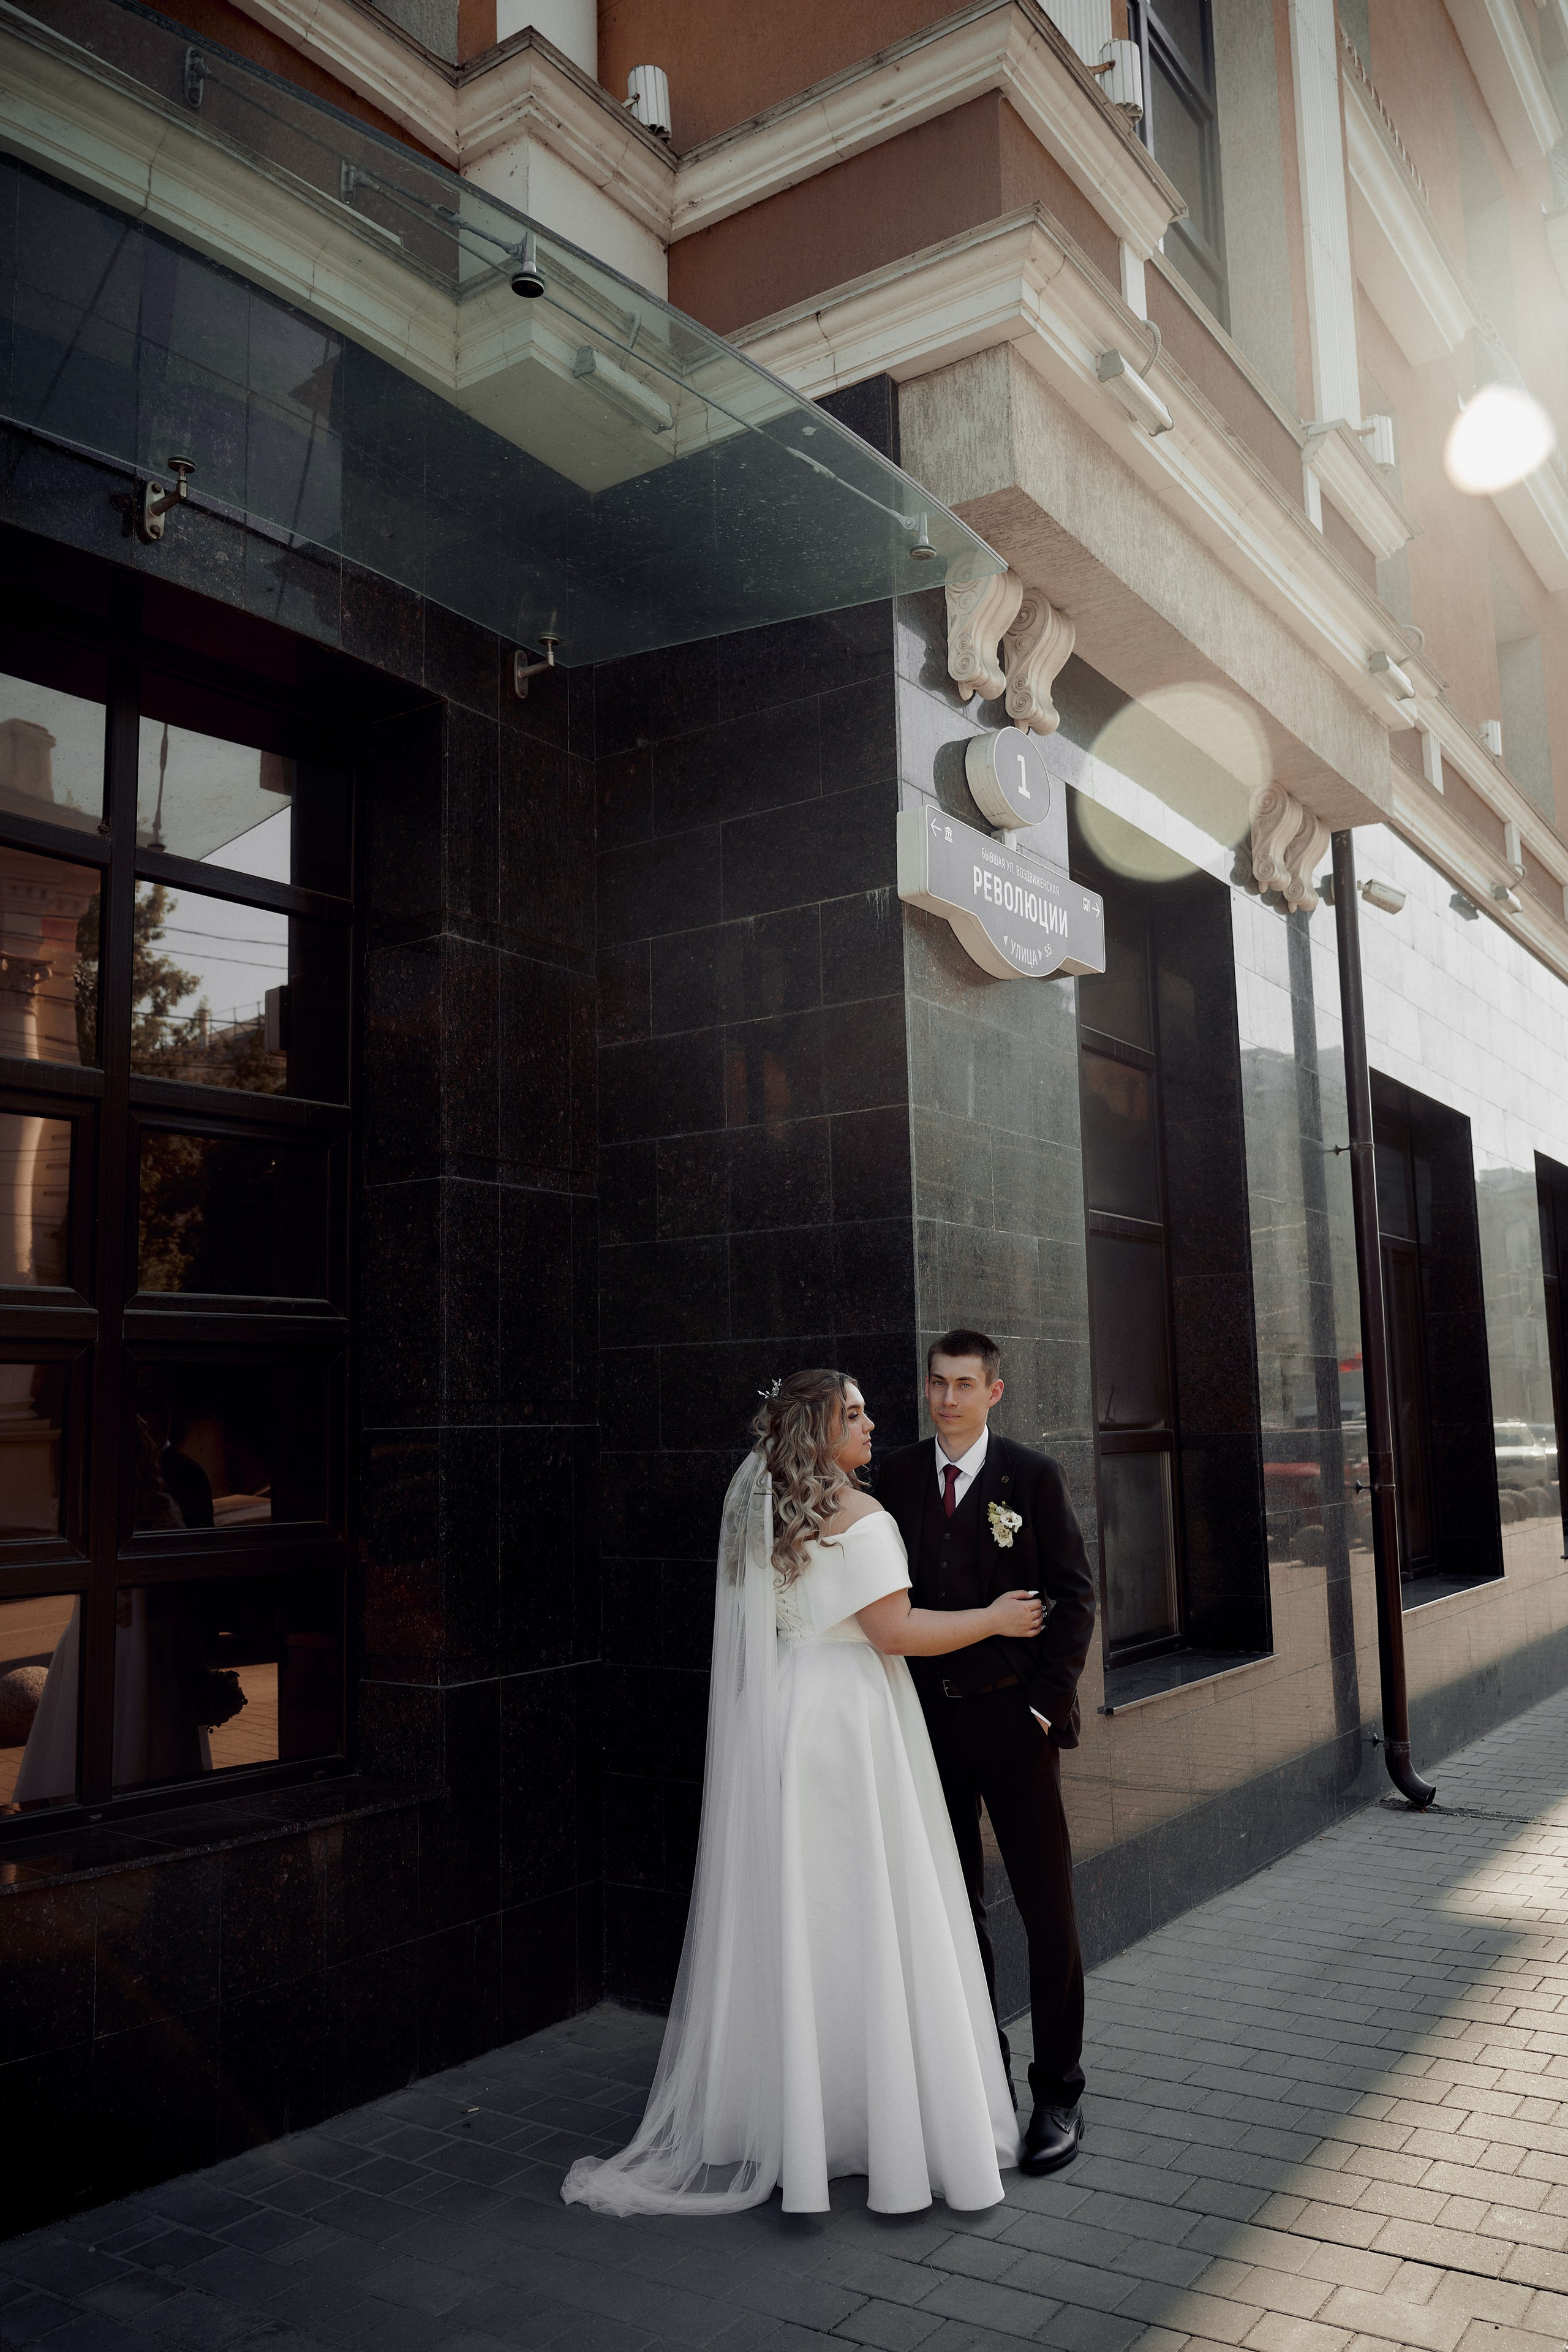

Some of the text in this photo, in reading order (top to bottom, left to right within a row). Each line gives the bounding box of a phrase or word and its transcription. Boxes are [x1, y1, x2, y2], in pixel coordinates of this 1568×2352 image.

[1016, 754, 1031, 799] 1
[981, 848, 1060, 897] БЫВШАЯ УЛ. ВОЗДВИЖЕНСКАЯ
[973, 865, 1068, 938] РЕВОЛЮЦИИ
[1011, 939, 1038, 968] УЛИЦА
[1044, 943, 1052, 957] 55
